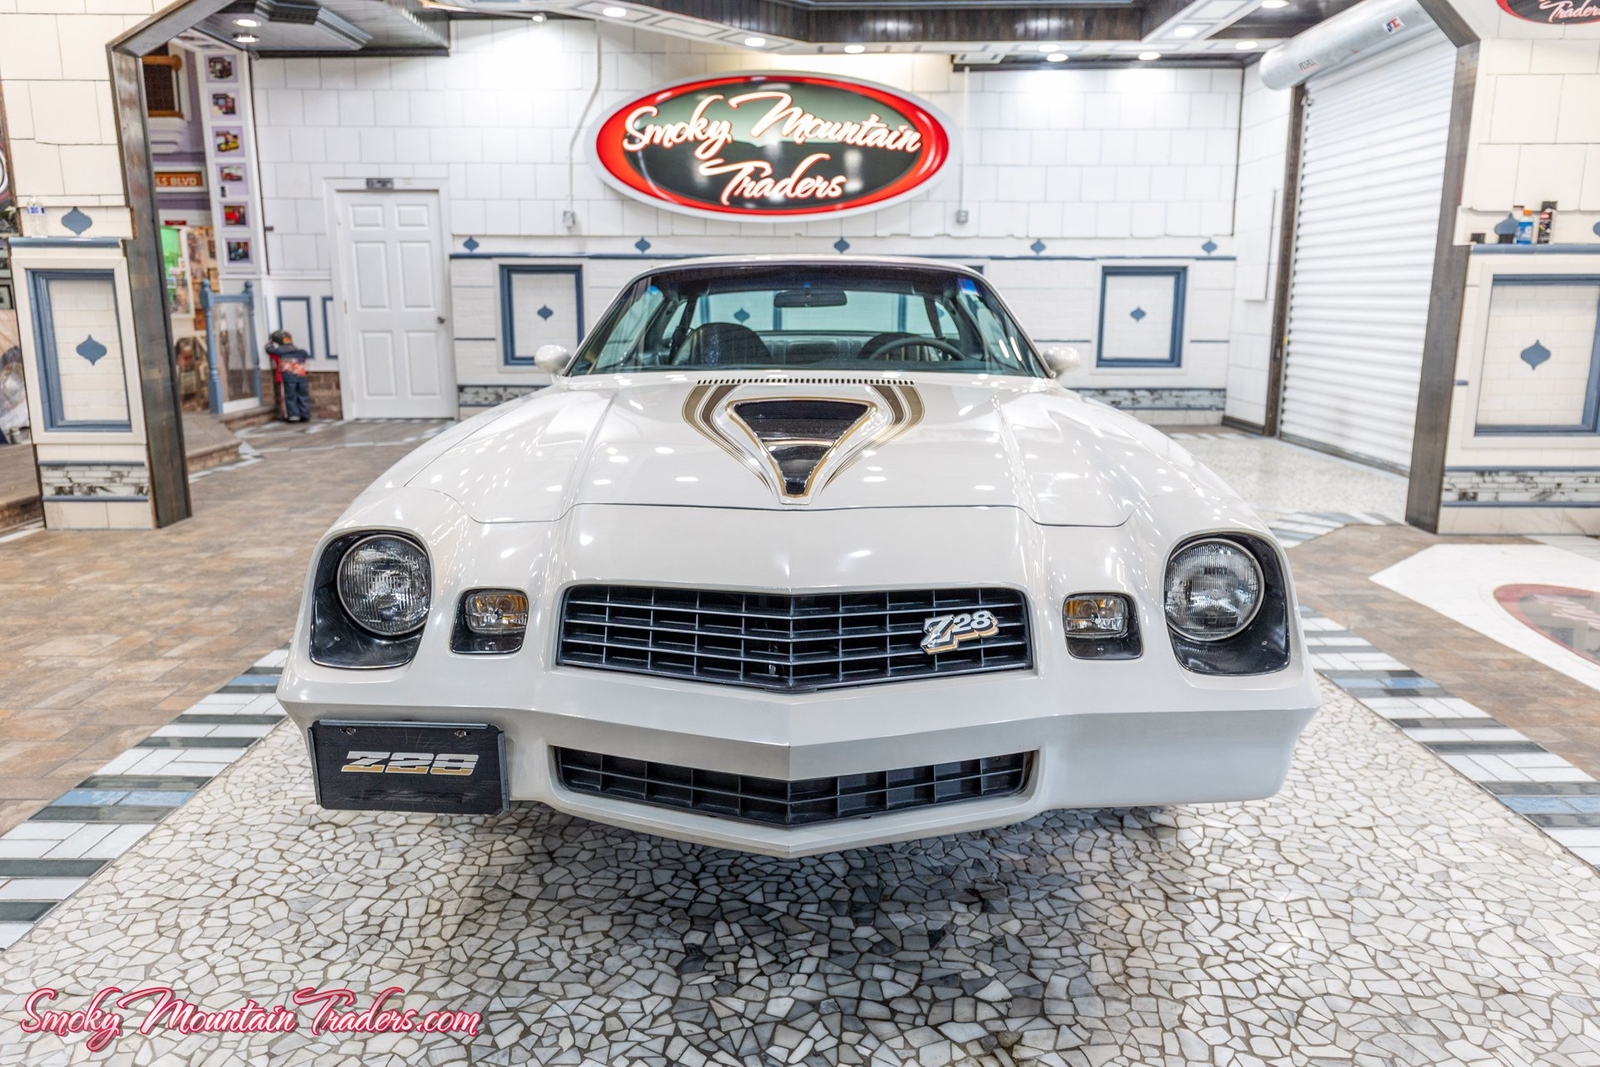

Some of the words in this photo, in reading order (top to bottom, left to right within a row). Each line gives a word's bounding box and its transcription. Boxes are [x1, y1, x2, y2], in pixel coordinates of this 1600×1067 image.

[1540, 0, 1600, 22] Trader
[622, 94, 732, 159] Smoky
[728, 91, 922, 153] Mountain
[170, 176, 198, 187] BLVD
[698, 153, 848, 206] Traders
[920, 610, 999, 655] Z28
[341, 750, 480, 776] Z28
